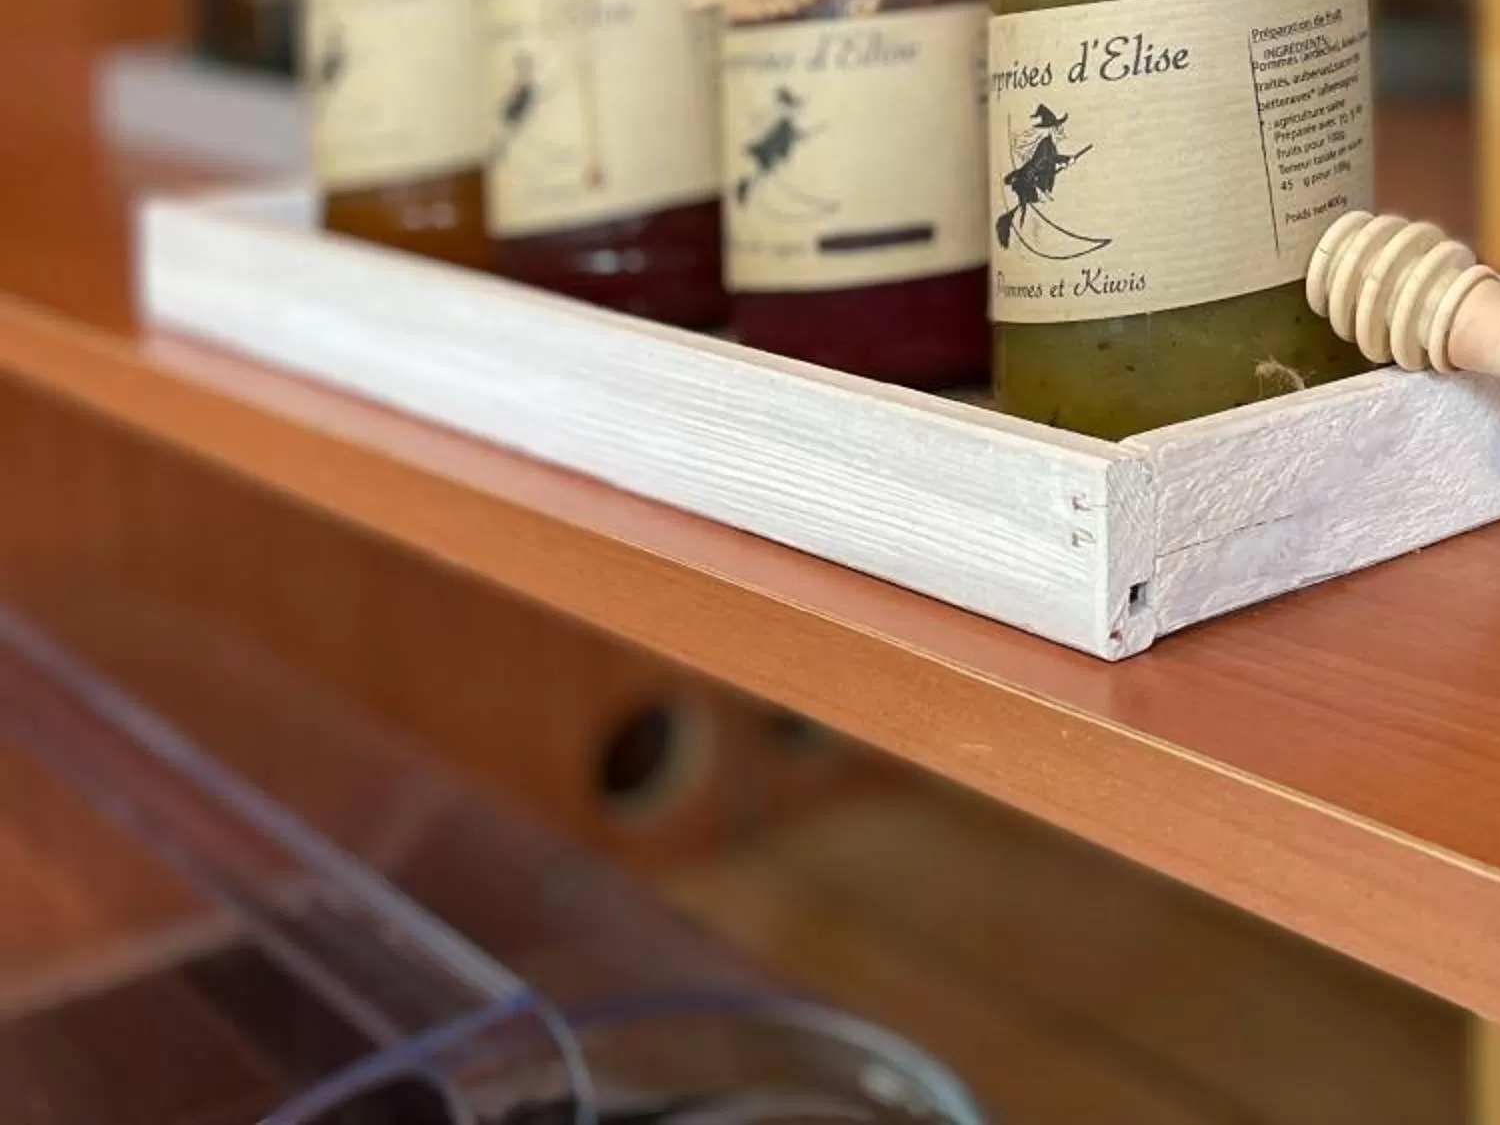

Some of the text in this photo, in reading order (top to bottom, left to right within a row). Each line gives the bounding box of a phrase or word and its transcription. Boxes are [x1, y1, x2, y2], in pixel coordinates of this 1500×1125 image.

[992, 32, 1190, 99] prises d'Elise
[1050, 279, 1065, 298] et
[1073, 267, 1148, 296] Kiwis
